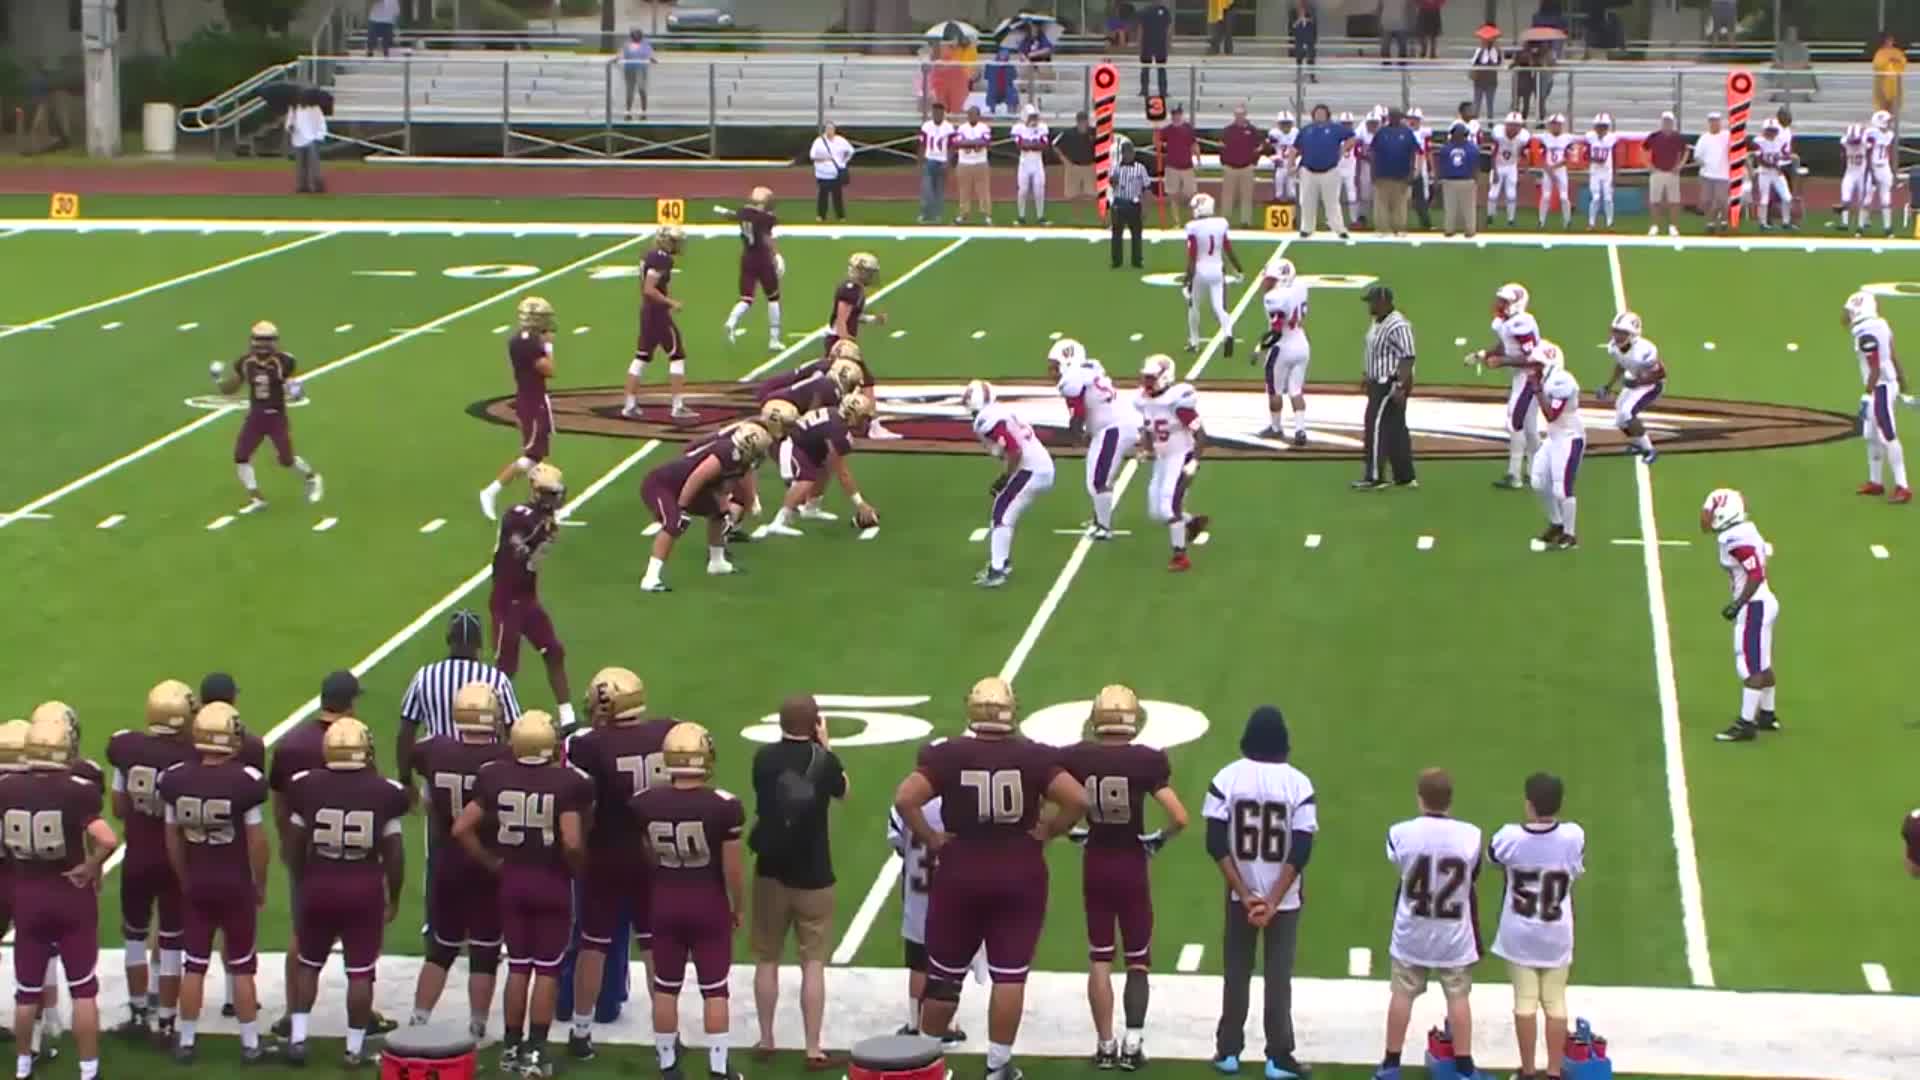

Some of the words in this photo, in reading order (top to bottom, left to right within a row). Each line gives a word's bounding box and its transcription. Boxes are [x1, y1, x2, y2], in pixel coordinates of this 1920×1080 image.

[660, 202, 681, 220] 40
[1270, 208, 1290, 229] 50
[497, 789, 555, 846] 24
[961, 768, 1023, 824] 70
[1085, 774, 1130, 825] 18
[313, 807, 375, 861] 33
[1230, 798, 1289, 863] 66
[1405, 855, 1466, 920] 42
[1511, 869, 1570, 924] 50
